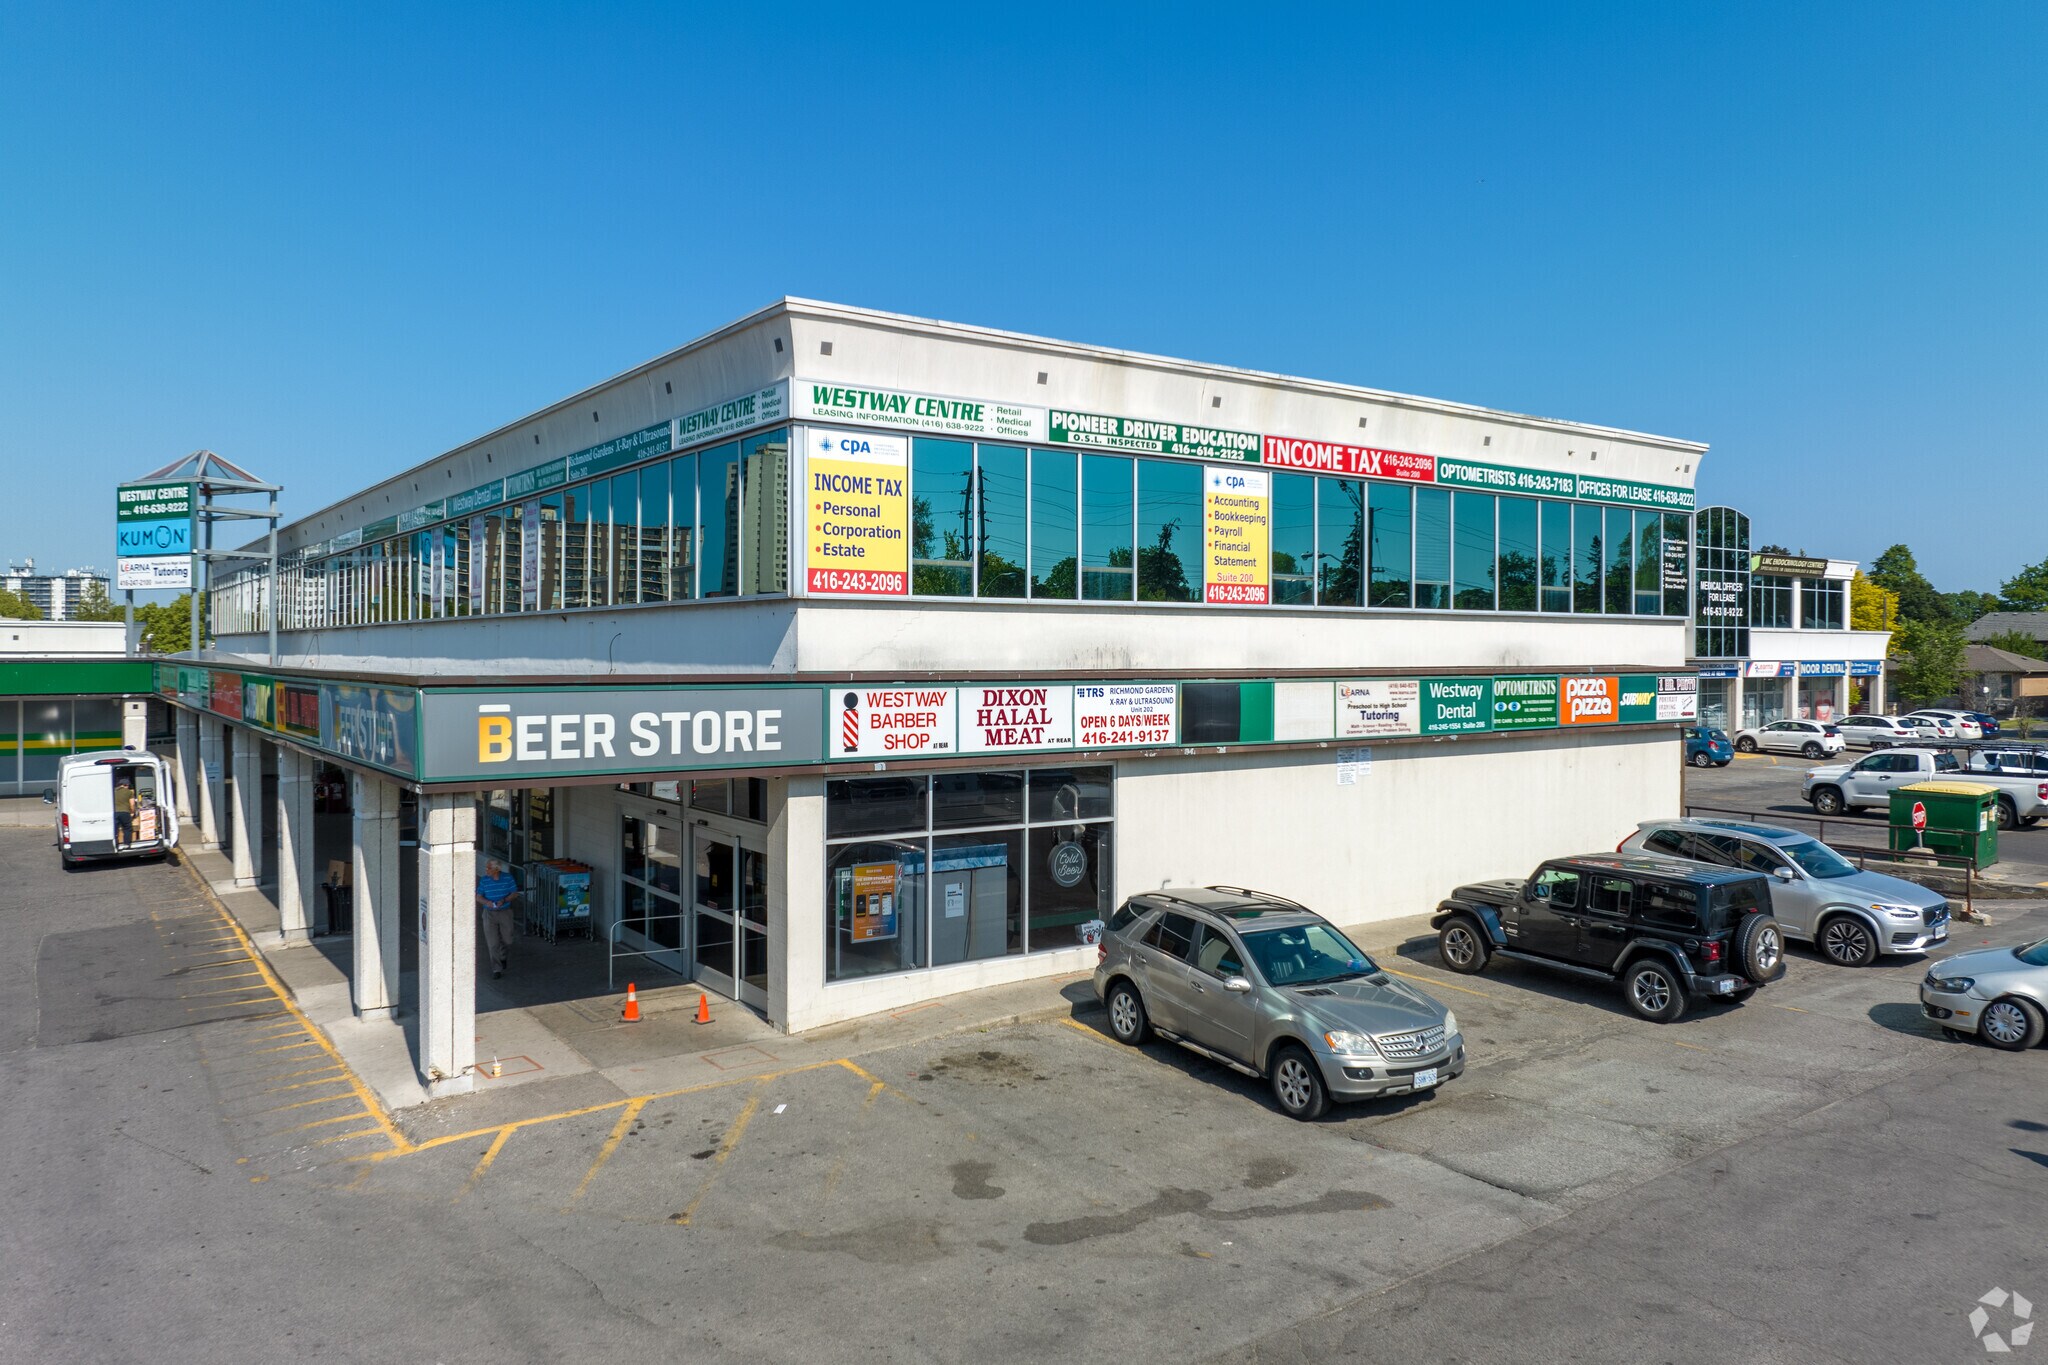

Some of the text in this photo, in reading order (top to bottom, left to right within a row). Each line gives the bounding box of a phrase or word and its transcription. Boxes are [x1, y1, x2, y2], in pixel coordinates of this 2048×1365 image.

[762, 388, 776, 399] Retail
[762, 397, 781, 409] Medical
[813, 386, 985, 421] WESTWAY CENTRE
[680, 394, 755, 435] WESTWAY CENTRE
[762, 410, 780, 420] Offices
[997, 407, 1022, 416] Retail
[813, 408, 984, 432] LEASING INFORMATION (416) 638-9222
[997, 417, 1032, 427] Medical
[997, 426, 1028, 436] Offices
[1052, 412, 1258, 451] PIONEER DRIVER EDUCATION
[569, 422, 672, 467] Richmond Gardens X-Ray & Ultrasound
[1074, 434, 1244, 460] O.S.L. INSPECTED 416-614-2123
[1267, 439, 1432, 474] INCOME TAX 416-243-2096
[1396, 469, 1409, 478] Suite
[1440, 463, 1573, 493] OPTOMETRISTS 416-243-7183
[814, 473, 902, 497] INCOME TAX
[120, 487, 188, 502] WESTWAY CENTRE
[453, 494, 474, 512] Westway
[474, 484, 492, 506] Dental
[1579, 480, 1694, 506] OFFICES FOR LEASE 416-638-9222
[823, 502, 880, 518] Personal
[1214, 496, 1259, 510] Accounting
[1214, 511, 1266, 526] Bookkeeping
[120, 526, 184, 548] KUMON
[823, 522, 900, 539] Corporation
[1214, 526, 1242, 538] Payroll
[823, 543, 865, 557] Estate
[1214, 541, 1250, 552] Financial
[121, 564, 150, 572] LEARNA
[1214, 556, 1256, 567] Statement
[153, 567, 188, 577] Tutoring
[1217, 572, 1253, 582] Suite 200
[813, 571, 902, 592] 416-243-2096
[1700, 581, 1743, 592] MEDICAL OFFICES
[1209, 585, 1265, 601] 416-243-2096
[1709, 593, 1736, 602] FOR LEASE
[1702, 607, 1743, 616] 416-638-9222
[1801, 664, 1820, 674] NOOR
[1822, 664, 1845, 674] DENTAL
[1086, 688, 1104, 697] TRS
[1341, 687, 1370, 697] LEARNA
[1429, 683, 1483, 700] Westway
[1494, 680, 1556, 696] OPTOMETRISTS
[1567, 679, 1607, 703] pizza
[866, 692, 947, 708] WESTWAY
[983, 689, 1047, 706] DIXON
[1620, 692, 1655, 706] SUBWAY
[977, 708, 1052, 726] HALAL
[1360, 710, 1399, 722] Tutoring
[1438, 702, 1476, 719] Dental
[1571, 697, 1612, 722] pizza
[871, 712, 936, 729] BARBER
[1081, 716, 1107, 728] OPEN
[1110, 716, 1115, 727] 6
[478, 709, 782, 763] BEER STORE
[884, 733, 930, 750] SHOP
[985, 728, 1045, 746] MEAT
[1082, 730, 1169, 744] 416-241-9137
[1914, 811, 1925, 824] STOP
[1060, 852, 1079, 864] Cold
[1058, 865, 1081, 877] Beer
